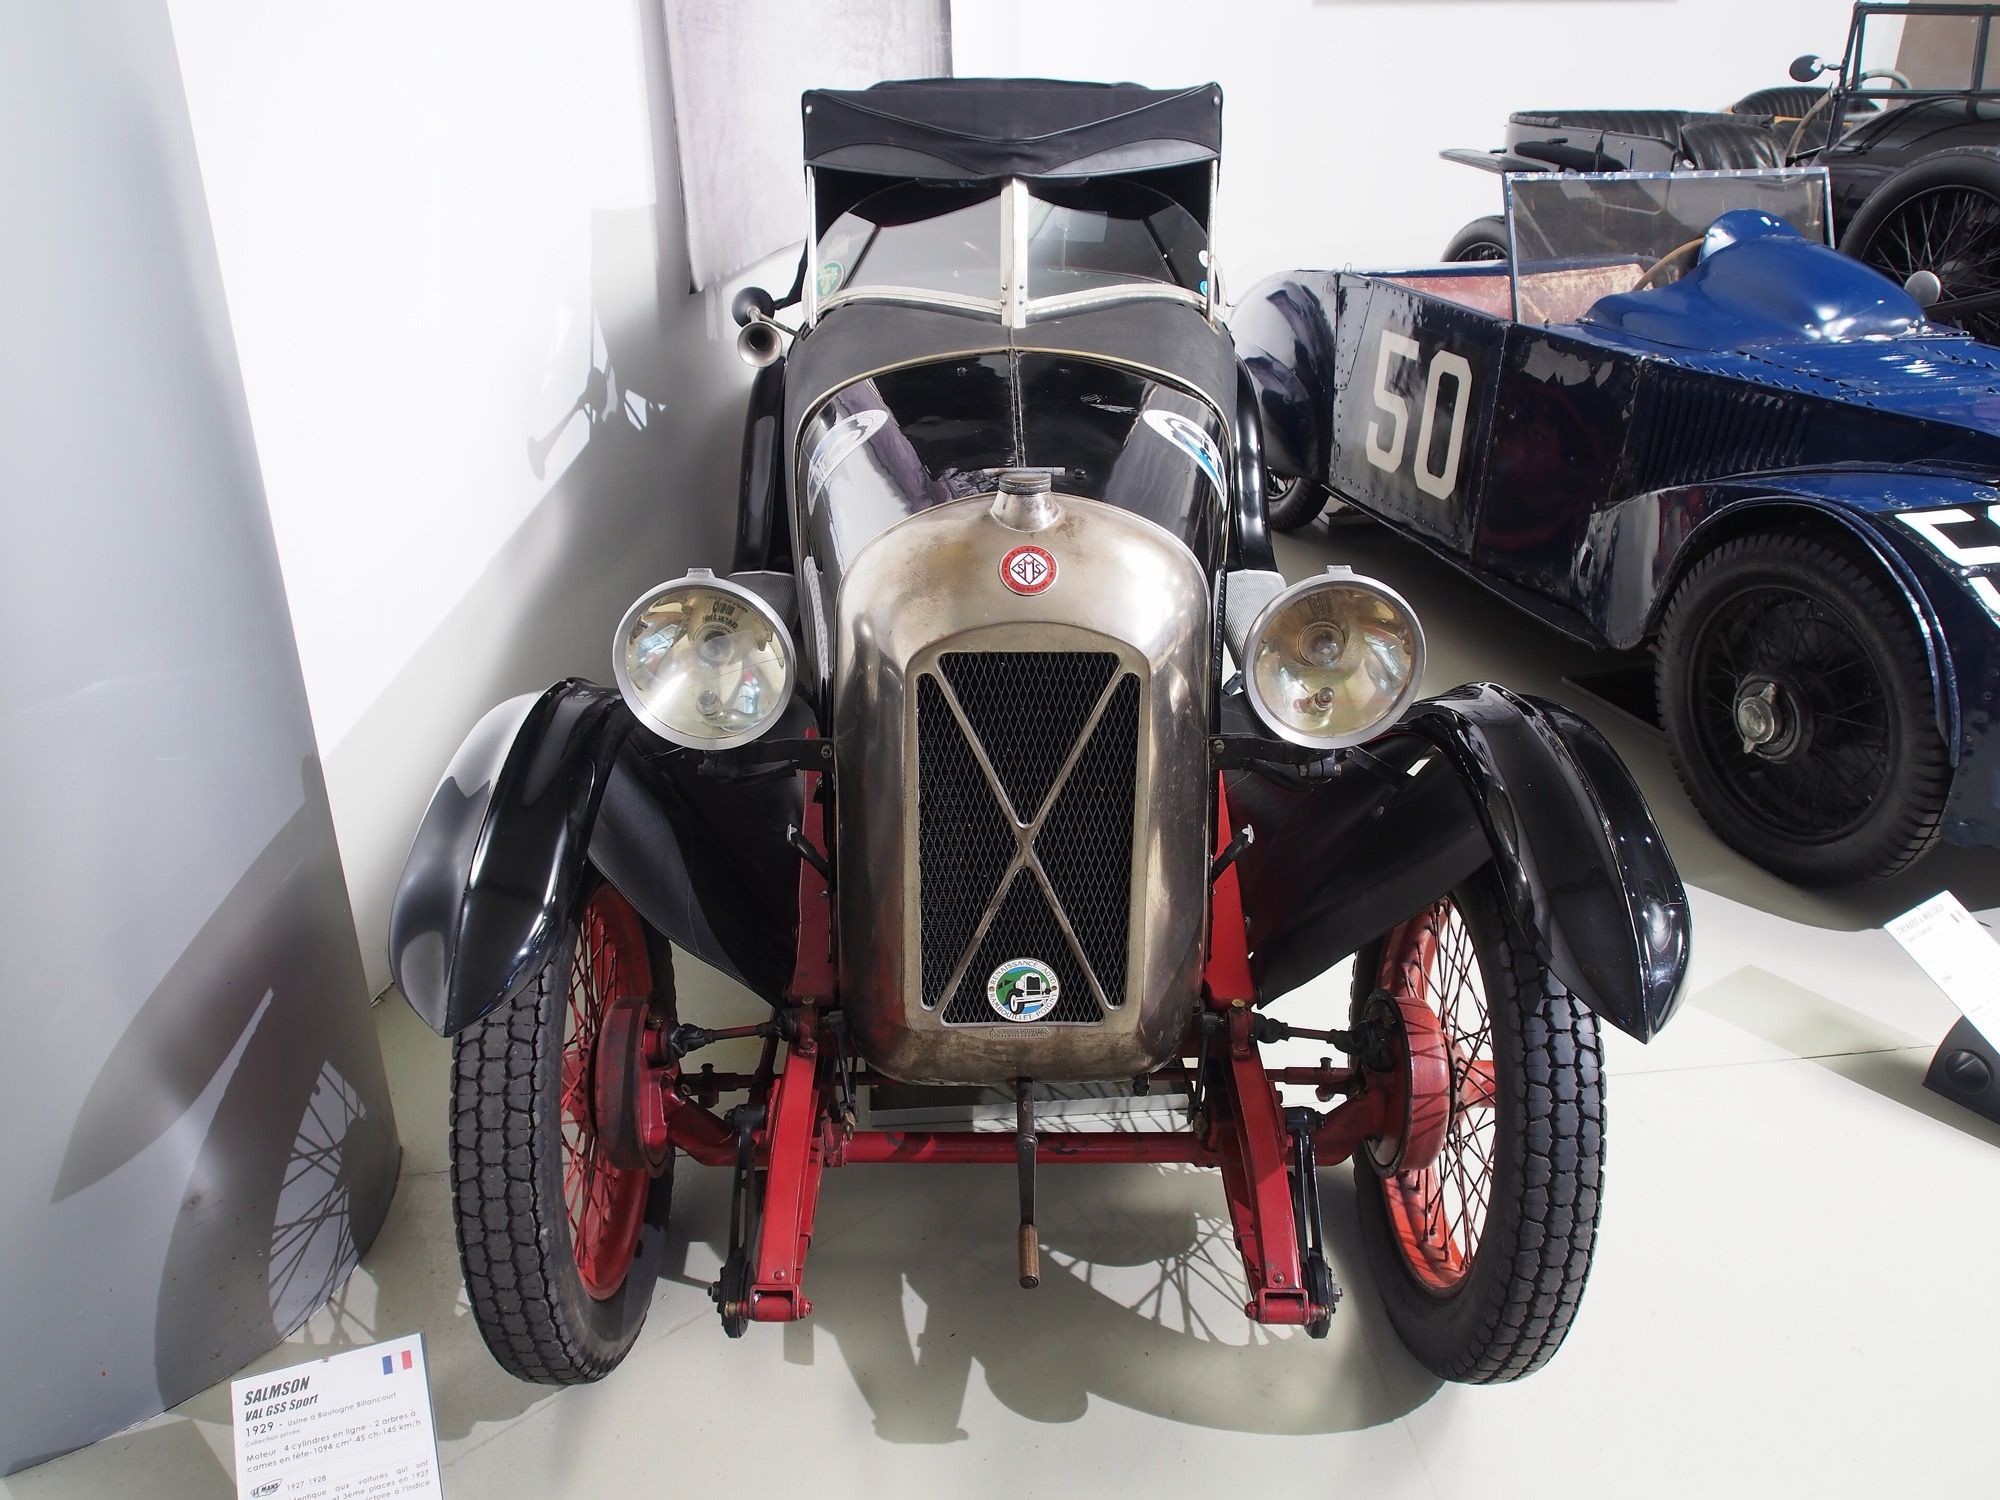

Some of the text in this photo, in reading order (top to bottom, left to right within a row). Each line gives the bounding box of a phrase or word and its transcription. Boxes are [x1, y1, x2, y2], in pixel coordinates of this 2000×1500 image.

[1365, 329, 1473, 500] 50
[990, 960, 1056, 985] RENAISSANCE AUTO
[989, 992, 1057, 1020] RAMBOUILLET POIGNY
[244, 1375, 310, 1406] SALMSON
[245, 1394, 319, 1422] VAL GSS Sport
[246, 1421, 274, 1437] 1929
[287, 1417, 308, 1426] Usine
[318, 1403, 355, 1418] Boulogne
[356, 1392, 397, 1407] Billancourt
[246, 1449, 277, 1462] Moteur
[291, 1434, 330, 1450] cylindres
[332, 1431, 344, 1439] en
[345, 1425, 366, 1436] ligne
[382, 1412, 408, 1425] arbres
[247, 1461, 277, 1473] cames
[279, 1456, 291, 1464] en
[399, 1419, 421, 1431] km/h
[335, 1483, 350, 1492] aux
[359, 1472, 388, 1485] voitures
[396, 1466, 408, 1475] qui
[416, 1460, 428, 1469] ont
[369, 1479, 395, 1493] places
[398, 1476, 409, 1484] en
[412, 1470, 429, 1479] 1927
